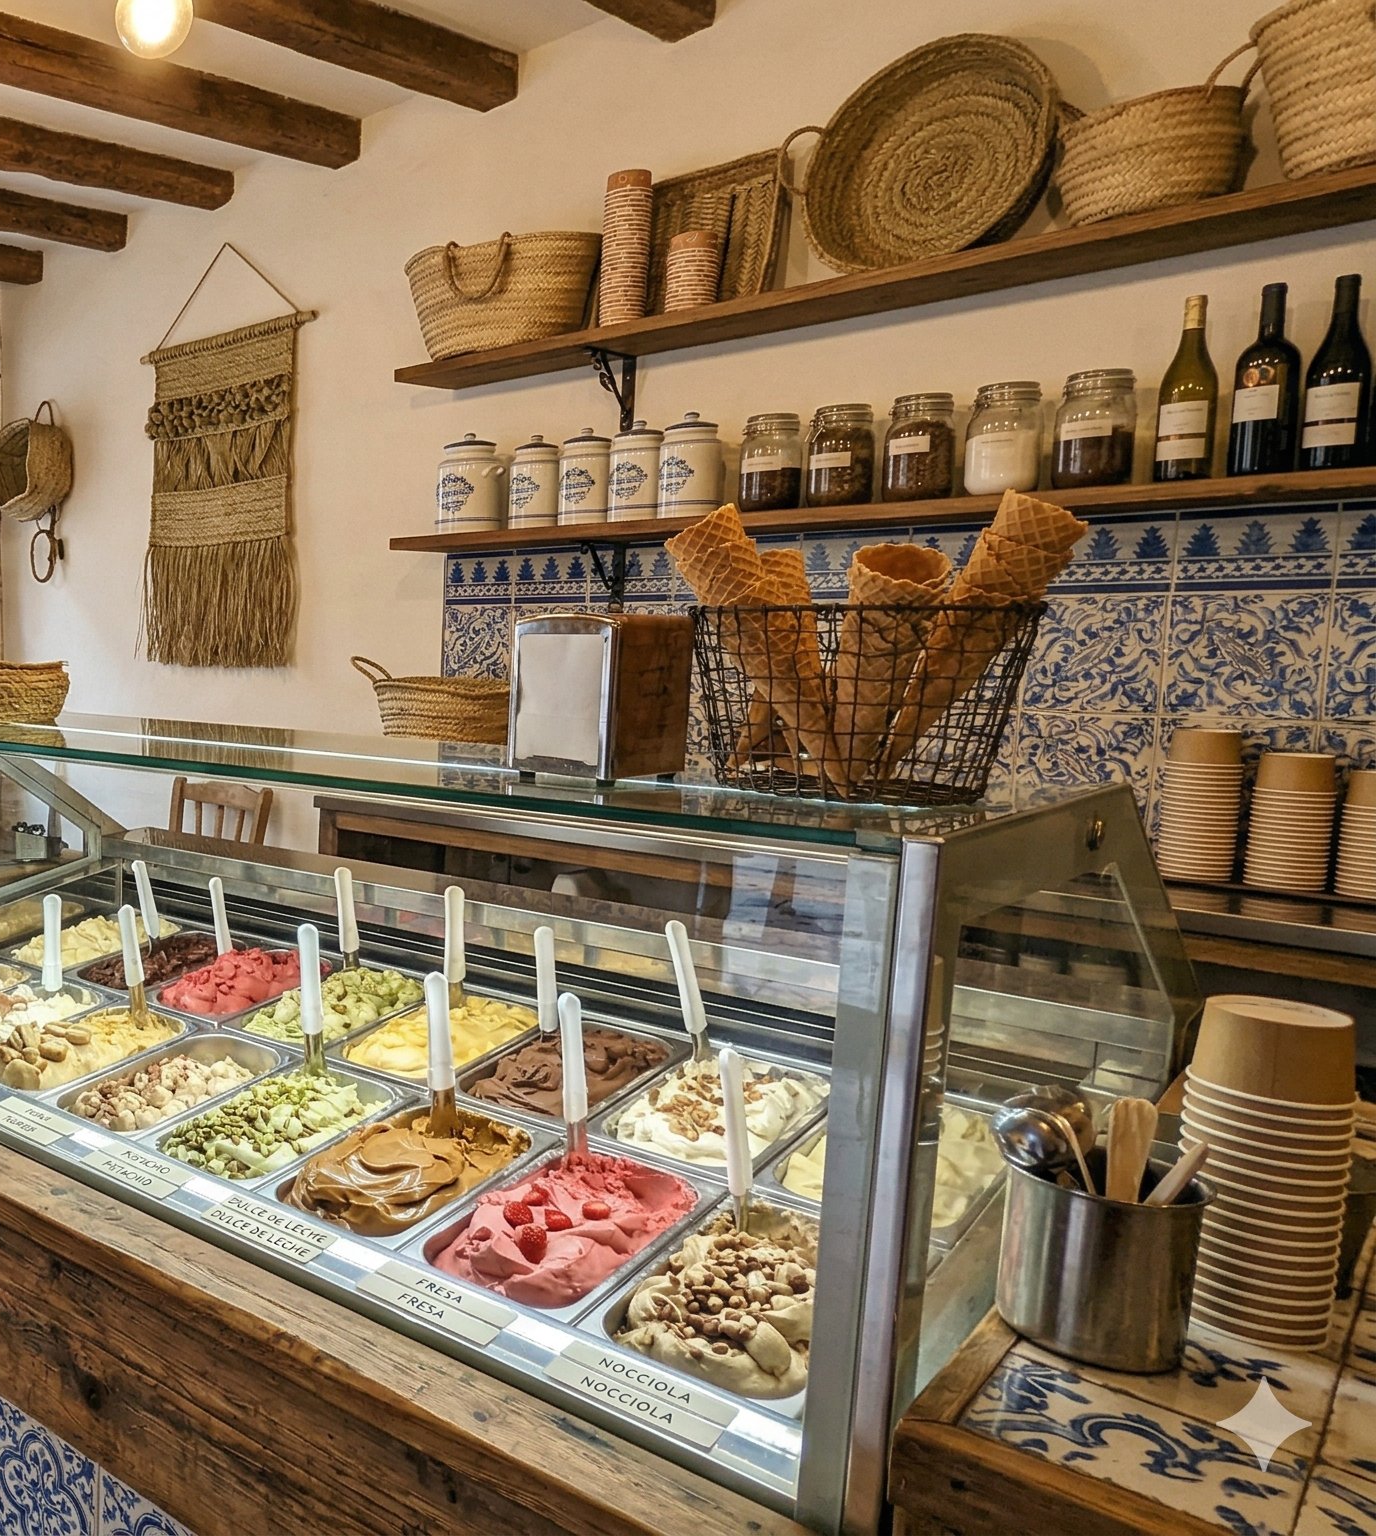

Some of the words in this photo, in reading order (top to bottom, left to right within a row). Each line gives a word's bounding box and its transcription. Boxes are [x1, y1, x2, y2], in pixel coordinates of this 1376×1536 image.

[249, 1226, 268, 1239] DE
[266, 1233, 311, 1257] LECHE
[284, 1220, 328, 1244] LECHE
[415, 1278, 462, 1304] FRESA
[397, 1293, 444, 1319] FRESA
[598, 1357, 691, 1404] NOCCIOLA
[580, 1376, 673, 1424] NOCCIOLA
